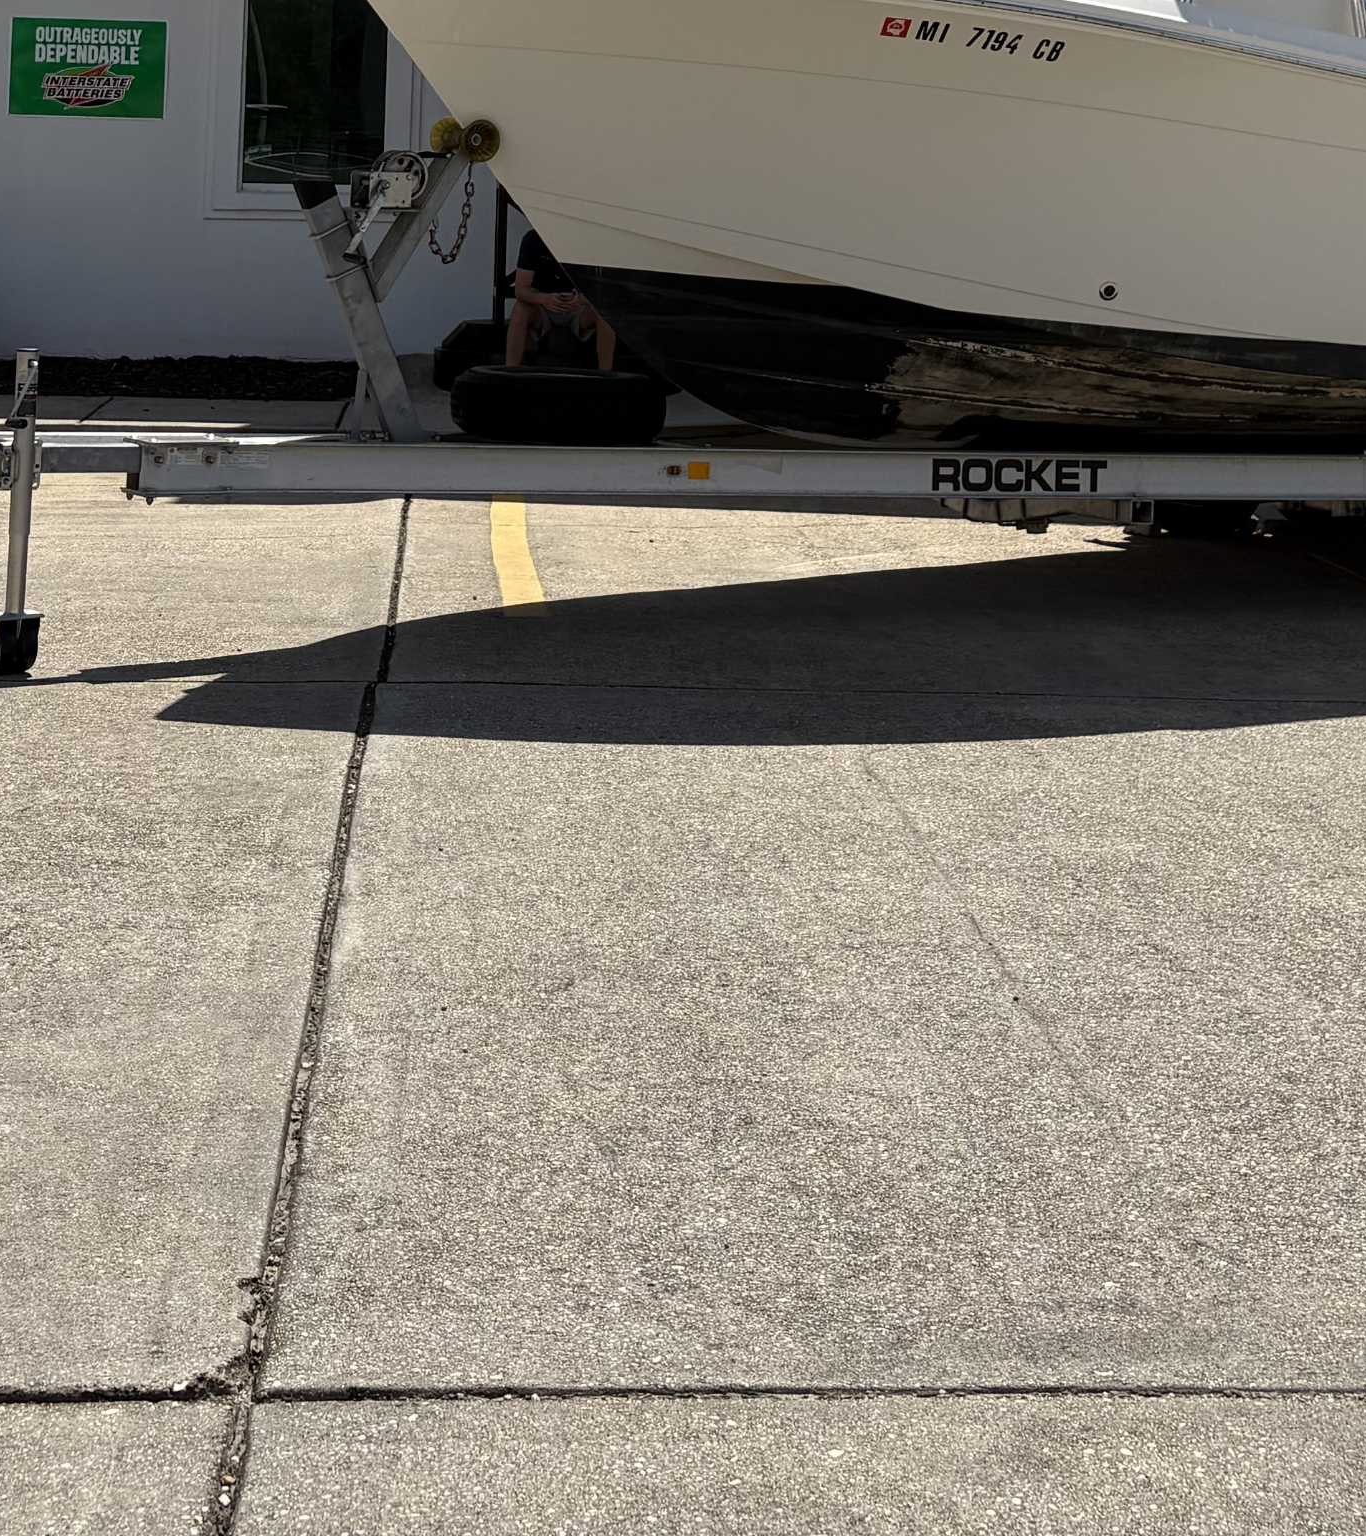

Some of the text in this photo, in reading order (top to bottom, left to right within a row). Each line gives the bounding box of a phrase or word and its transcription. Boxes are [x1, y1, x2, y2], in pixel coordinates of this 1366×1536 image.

[35, 26, 143, 45] OUTRAGEOUSLY
[915, 20, 1066, 62] MI 7194 CB
[35, 44, 140, 65] DEPENDABLE
[45, 75, 130, 89] INTERSTATE
[47, 87, 123, 99] BATTERIES
[931, 458, 1108, 493] ROCKET
